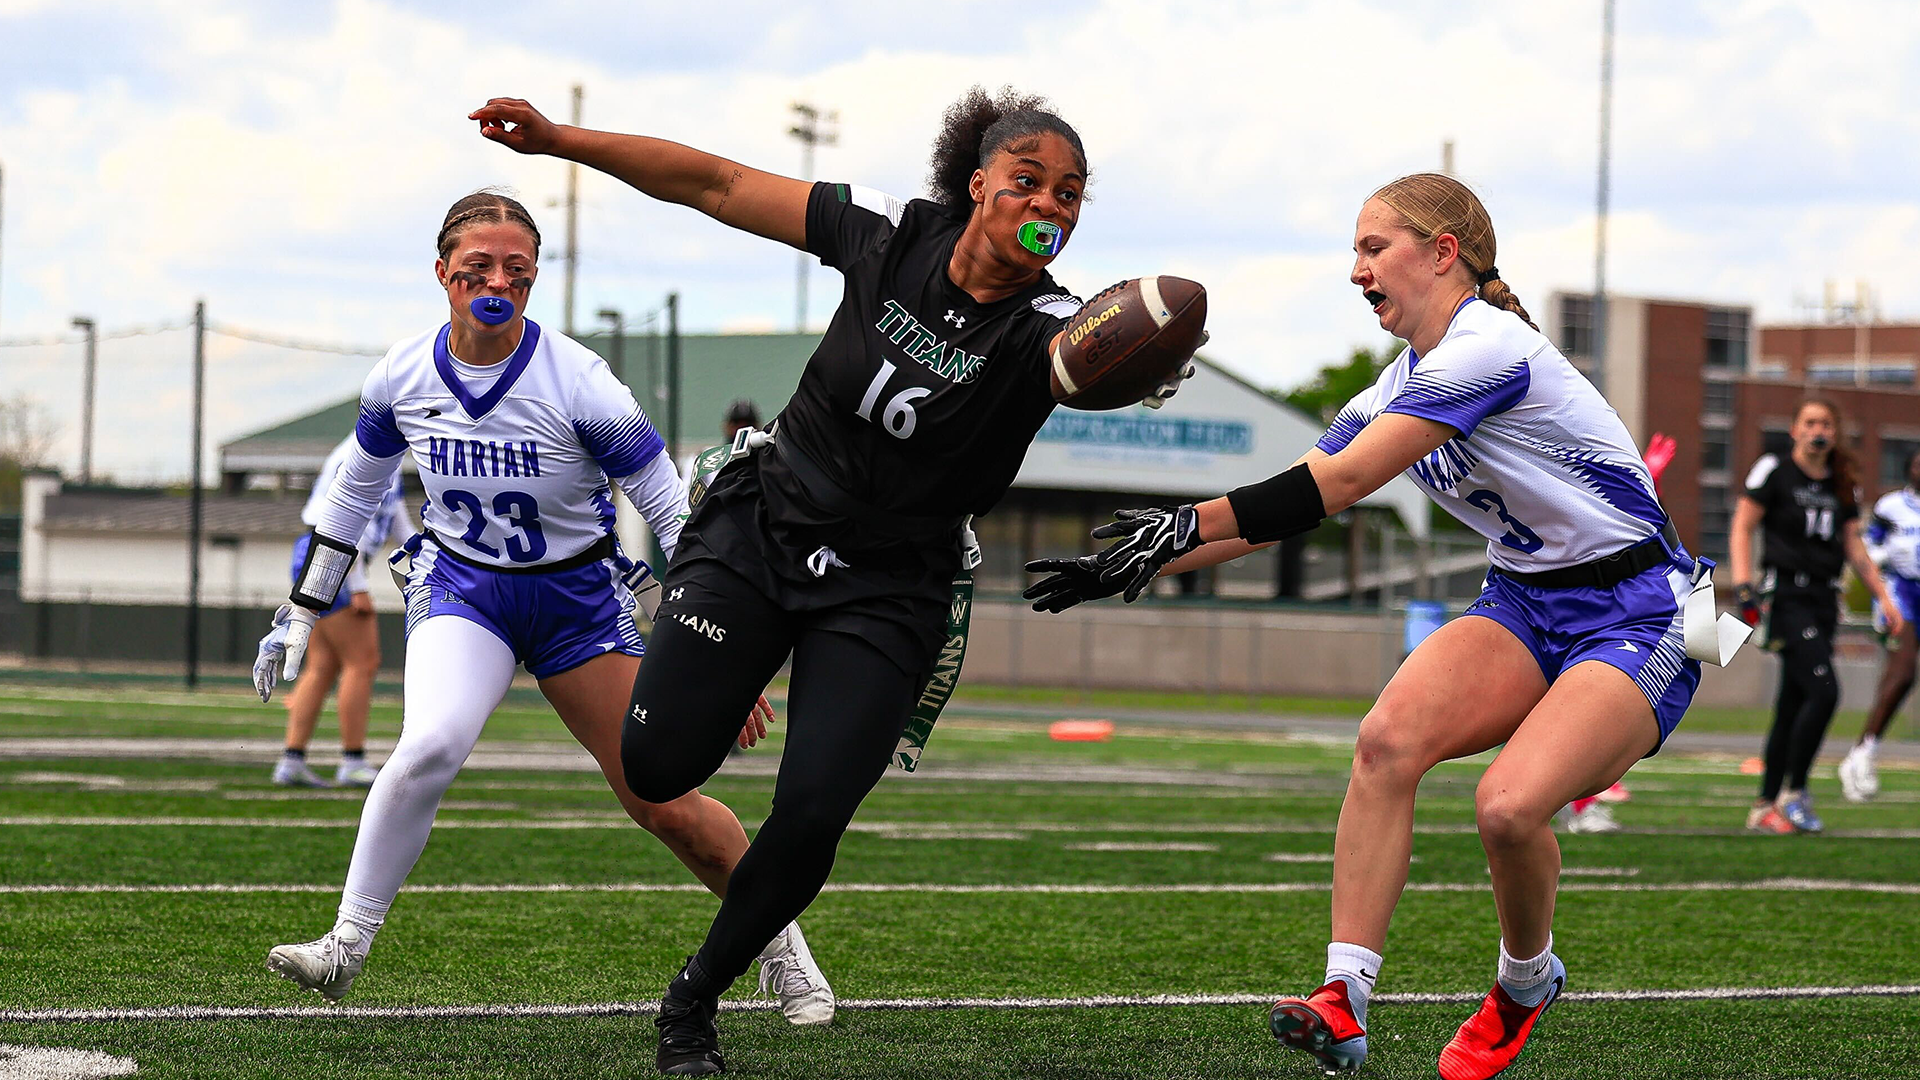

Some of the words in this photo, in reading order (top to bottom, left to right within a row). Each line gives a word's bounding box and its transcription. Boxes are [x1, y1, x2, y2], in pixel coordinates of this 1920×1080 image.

[875, 300, 987, 384] TITANS
[1069, 303, 1122, 346] Wilson
[1086, 327, 1123, 365] GST
[855, 355, 932, 440] 16
[429, 436, 541, 478] MARIAN
[442, 489, 547, 563] 23
[1465, 489, 1544, 555] 3
[918, 634, 965, 708] TITANS
